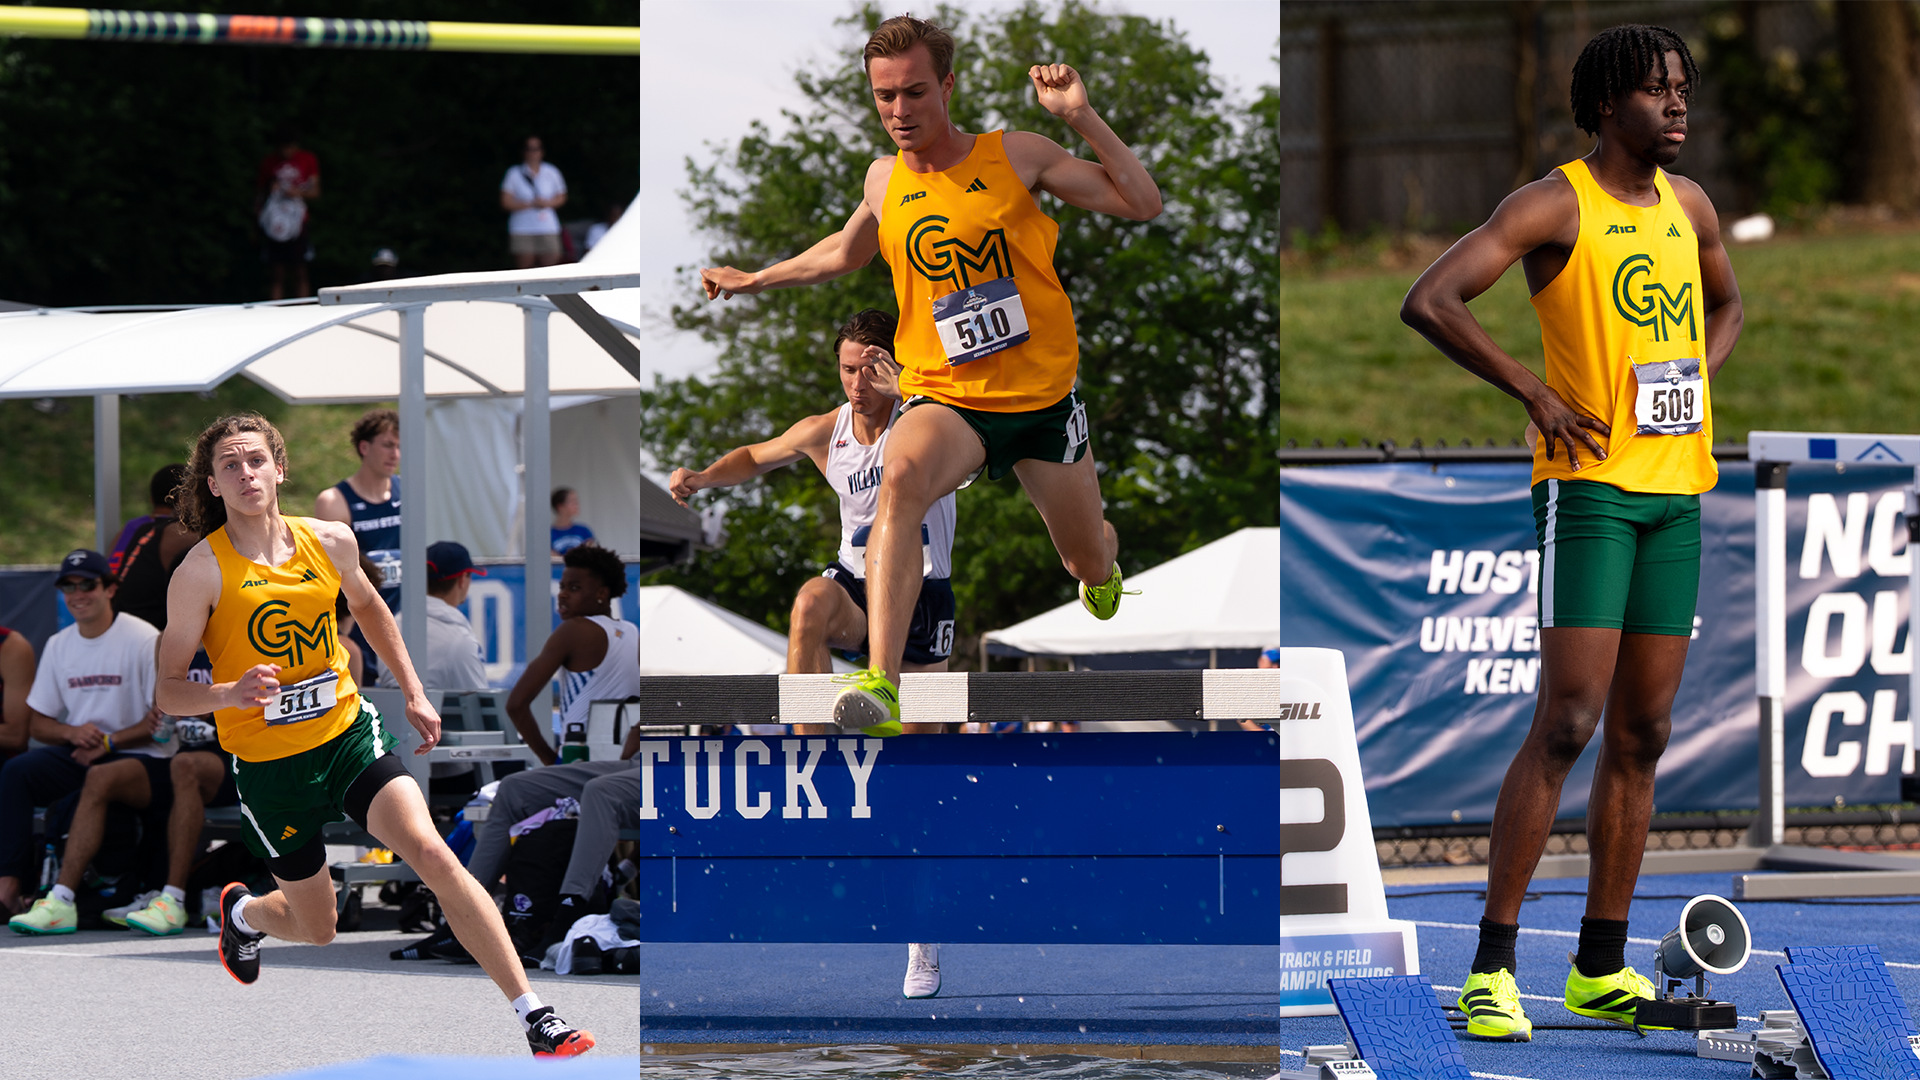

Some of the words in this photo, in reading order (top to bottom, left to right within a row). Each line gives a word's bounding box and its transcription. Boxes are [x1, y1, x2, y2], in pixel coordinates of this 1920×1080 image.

[898, 191, 927, 208] A10
[1604, 224, 1637, 236] A10
[906, 214, 1015, 291] GM
[1612, 253, 1698, 342] GM
[954, 307, 1011, 350] 510
[1652, 387, 1694, 422] 509
[847, 465, 884, 495] VILLAN
[241, 579, 269, 589] A10
[247, 599, 335, 668] GM
[941, 623, 952, 655] 6
[1419, 616, 1541, 653] UNIVE
[1463, 658, 1541, 695] KEN
[280, 687, 321, 715] 511
[1280, 702, 1322, 721] GILL
[640, 739, 883, 820] TUCKY
[1280, 951, 1321, 969] TRACK
[1323, 950, 1334, 966] &
[1335, 949, 1372, 965] FIELD
[1333, 1061, 1366, 1070] GILL
